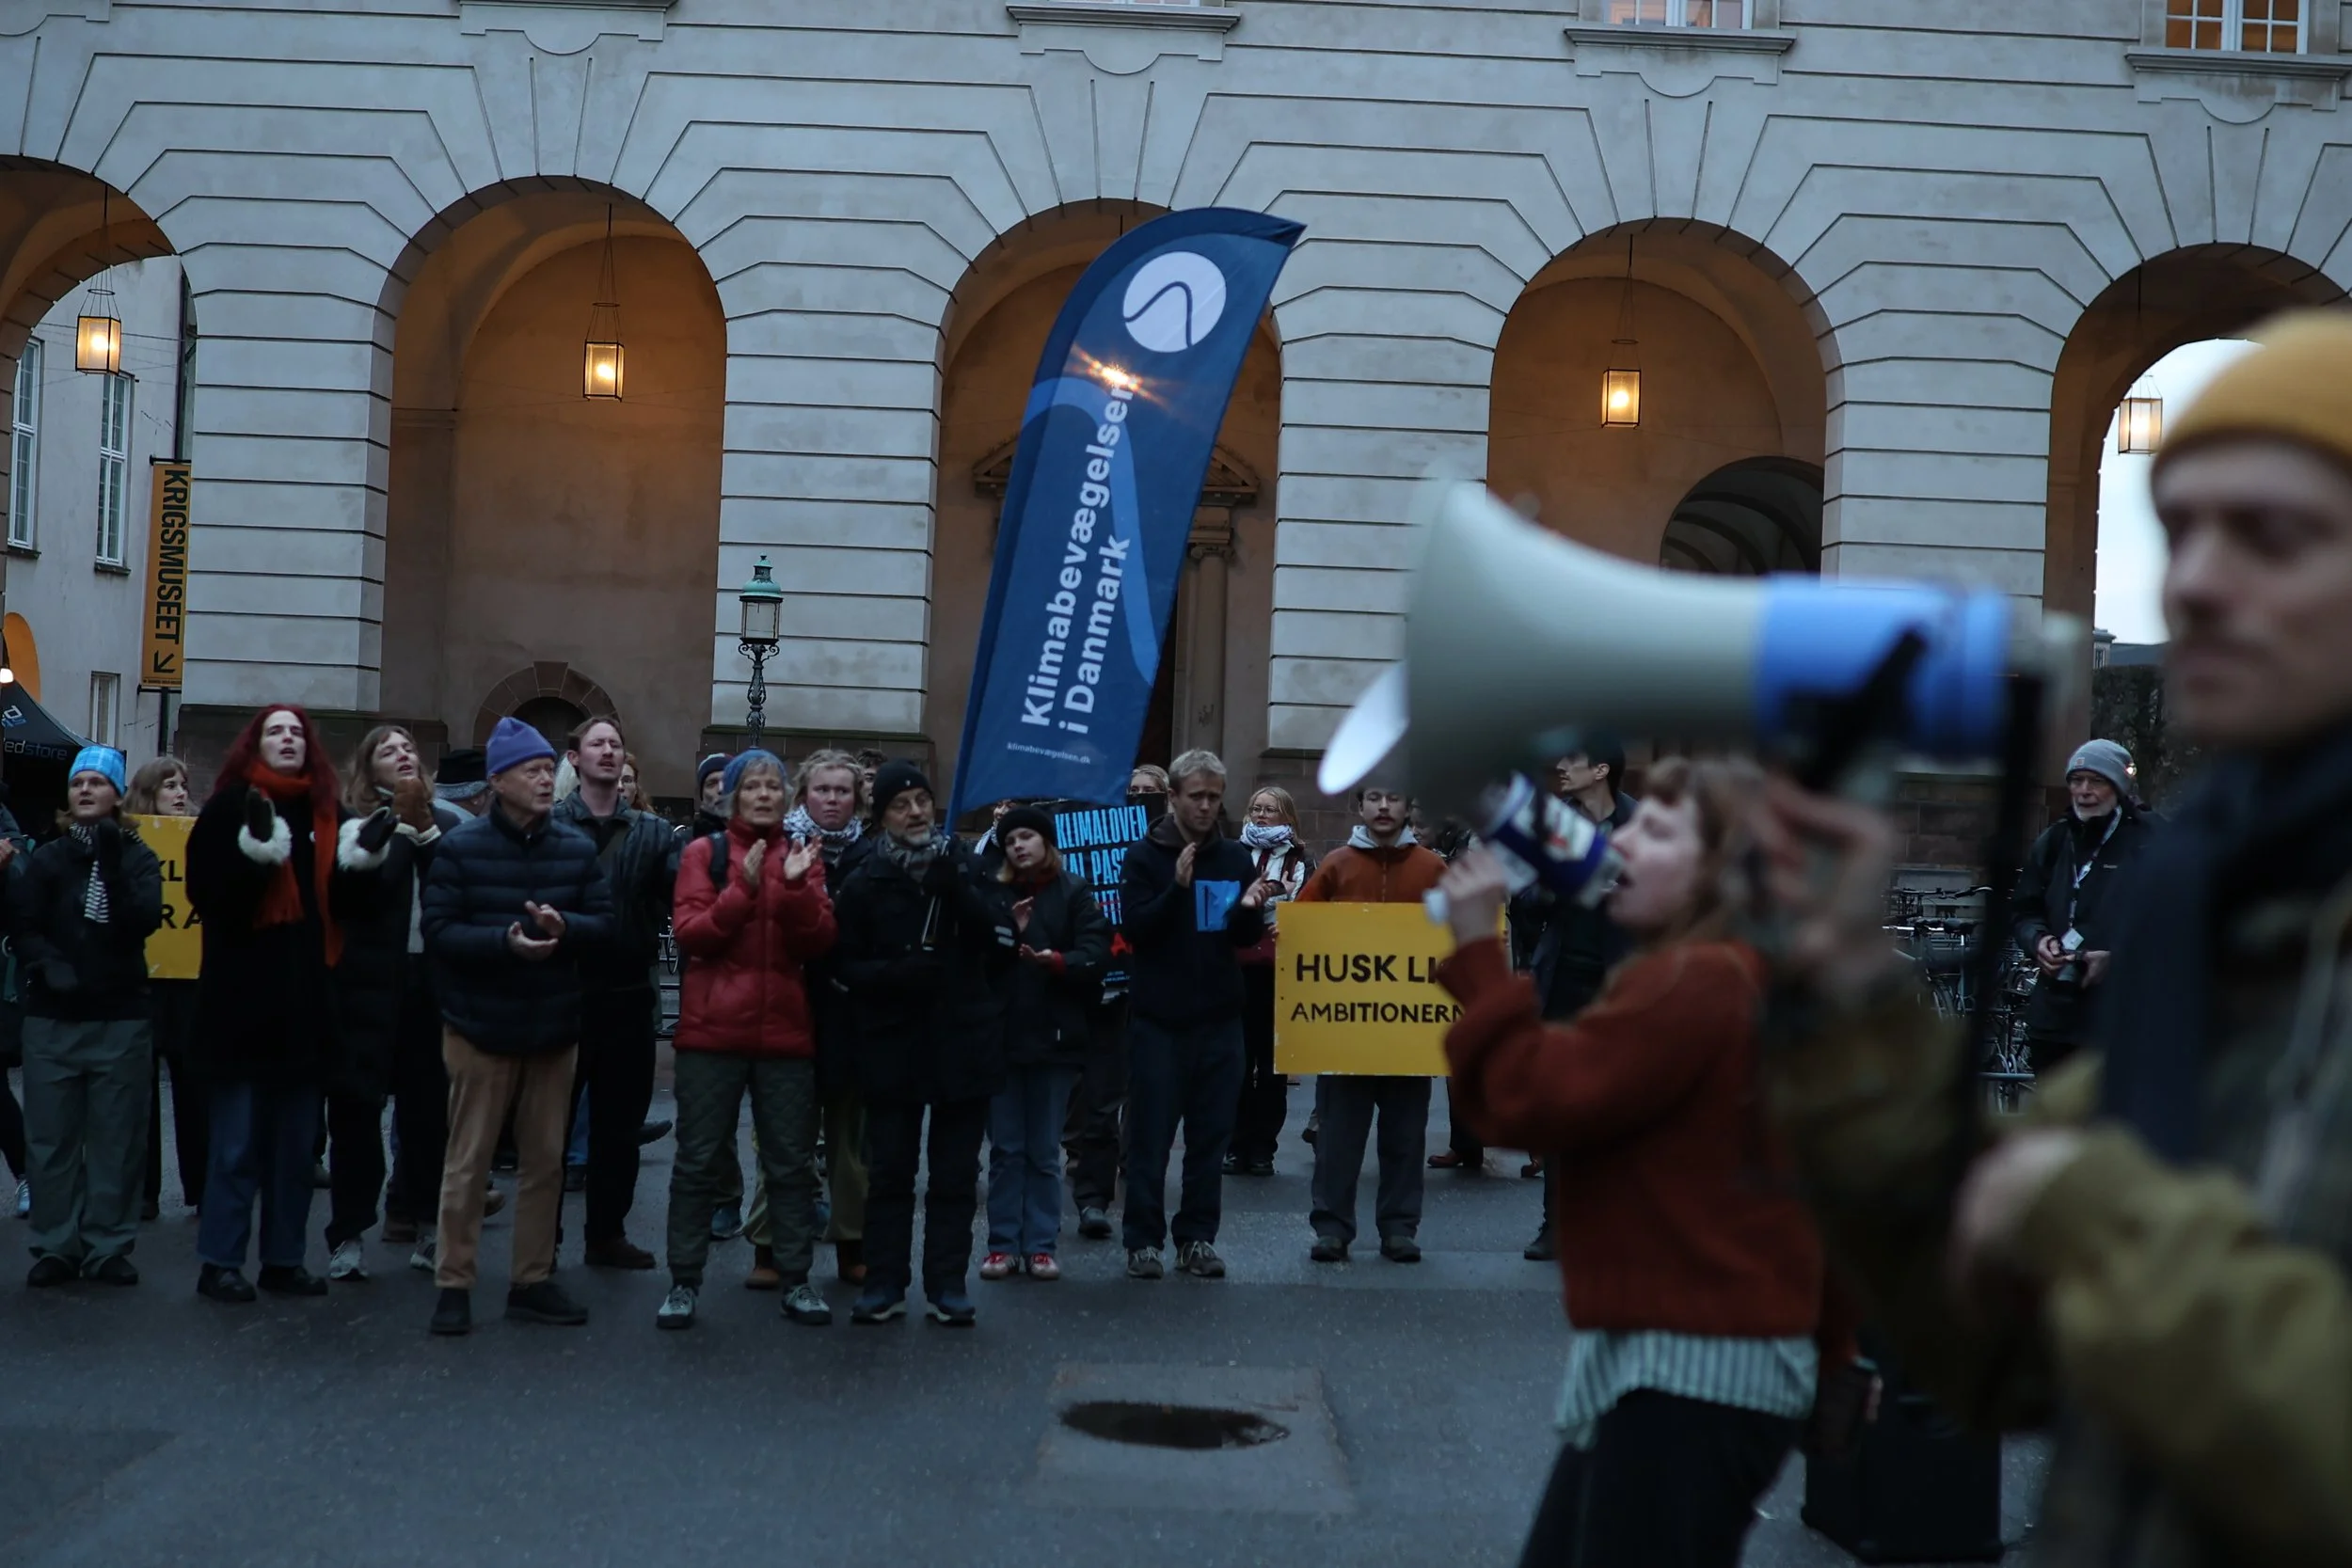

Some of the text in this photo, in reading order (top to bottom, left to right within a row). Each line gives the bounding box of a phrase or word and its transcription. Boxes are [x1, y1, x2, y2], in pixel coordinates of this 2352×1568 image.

[155, 468, 189, 645] KRIGSMUSEET
[1060, 534, 1131, 735] i Danmark
[4, 737, 68, 760] edstore
[1055, 805, 1148, 850] KLIMALOVEN
[1296, 954, 1398, 982] HUSK
